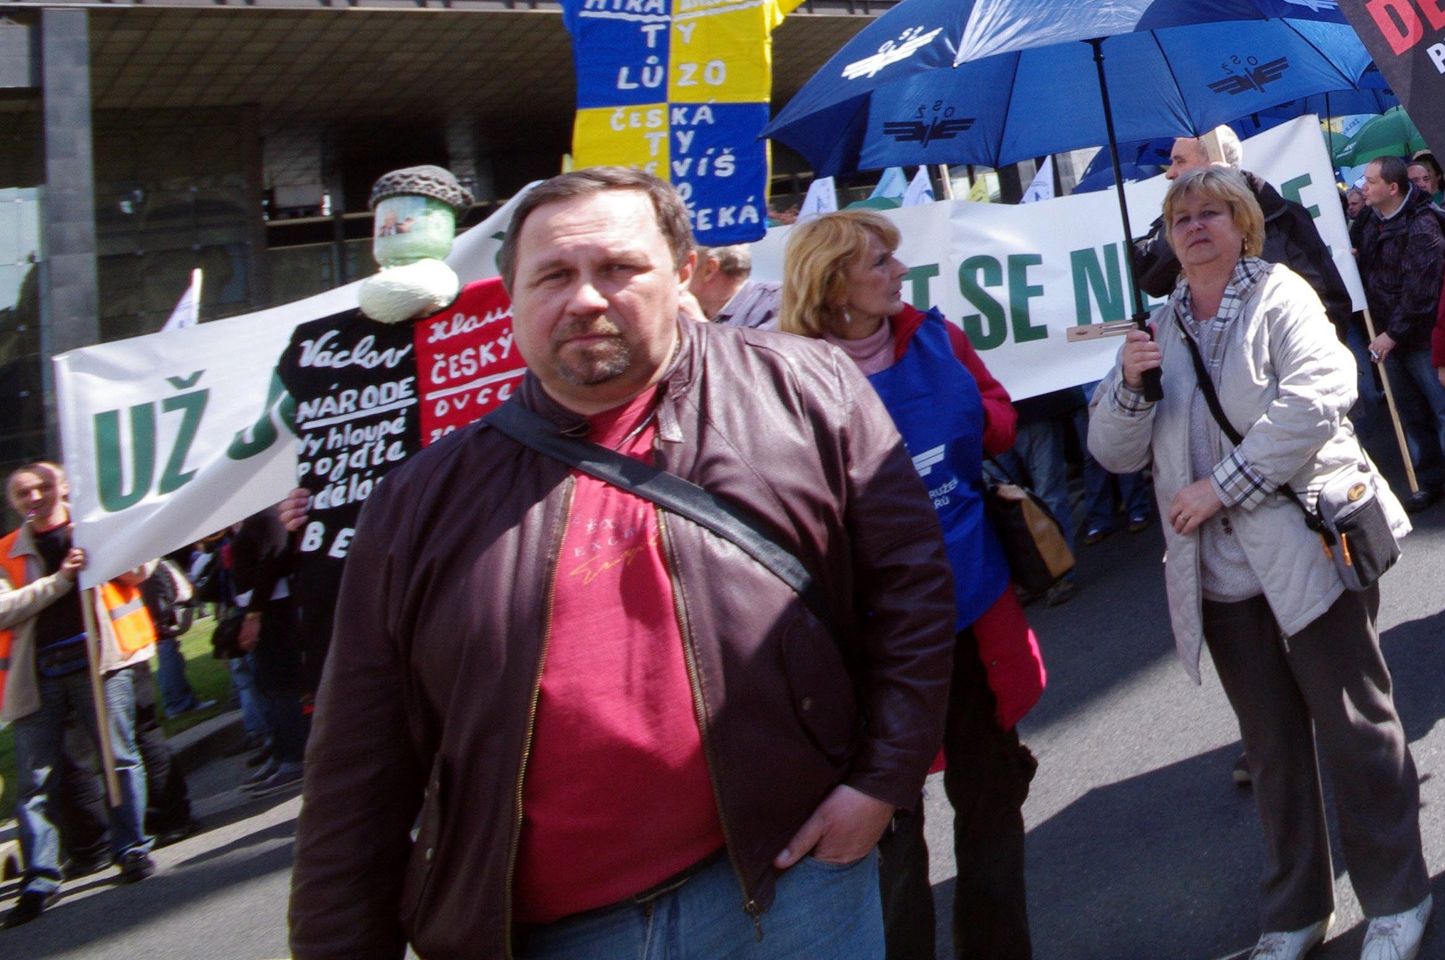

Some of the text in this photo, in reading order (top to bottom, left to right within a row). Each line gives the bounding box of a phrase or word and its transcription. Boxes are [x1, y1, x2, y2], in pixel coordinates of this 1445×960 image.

[958, 253, 1049, 351] SE
[299, 329, 413, 369] Václav
[431, 328, 514, 384] ČESKÝ
[296, 376, 416, 424] NÁRODE
[94, 370, 210, 513] UŽ
